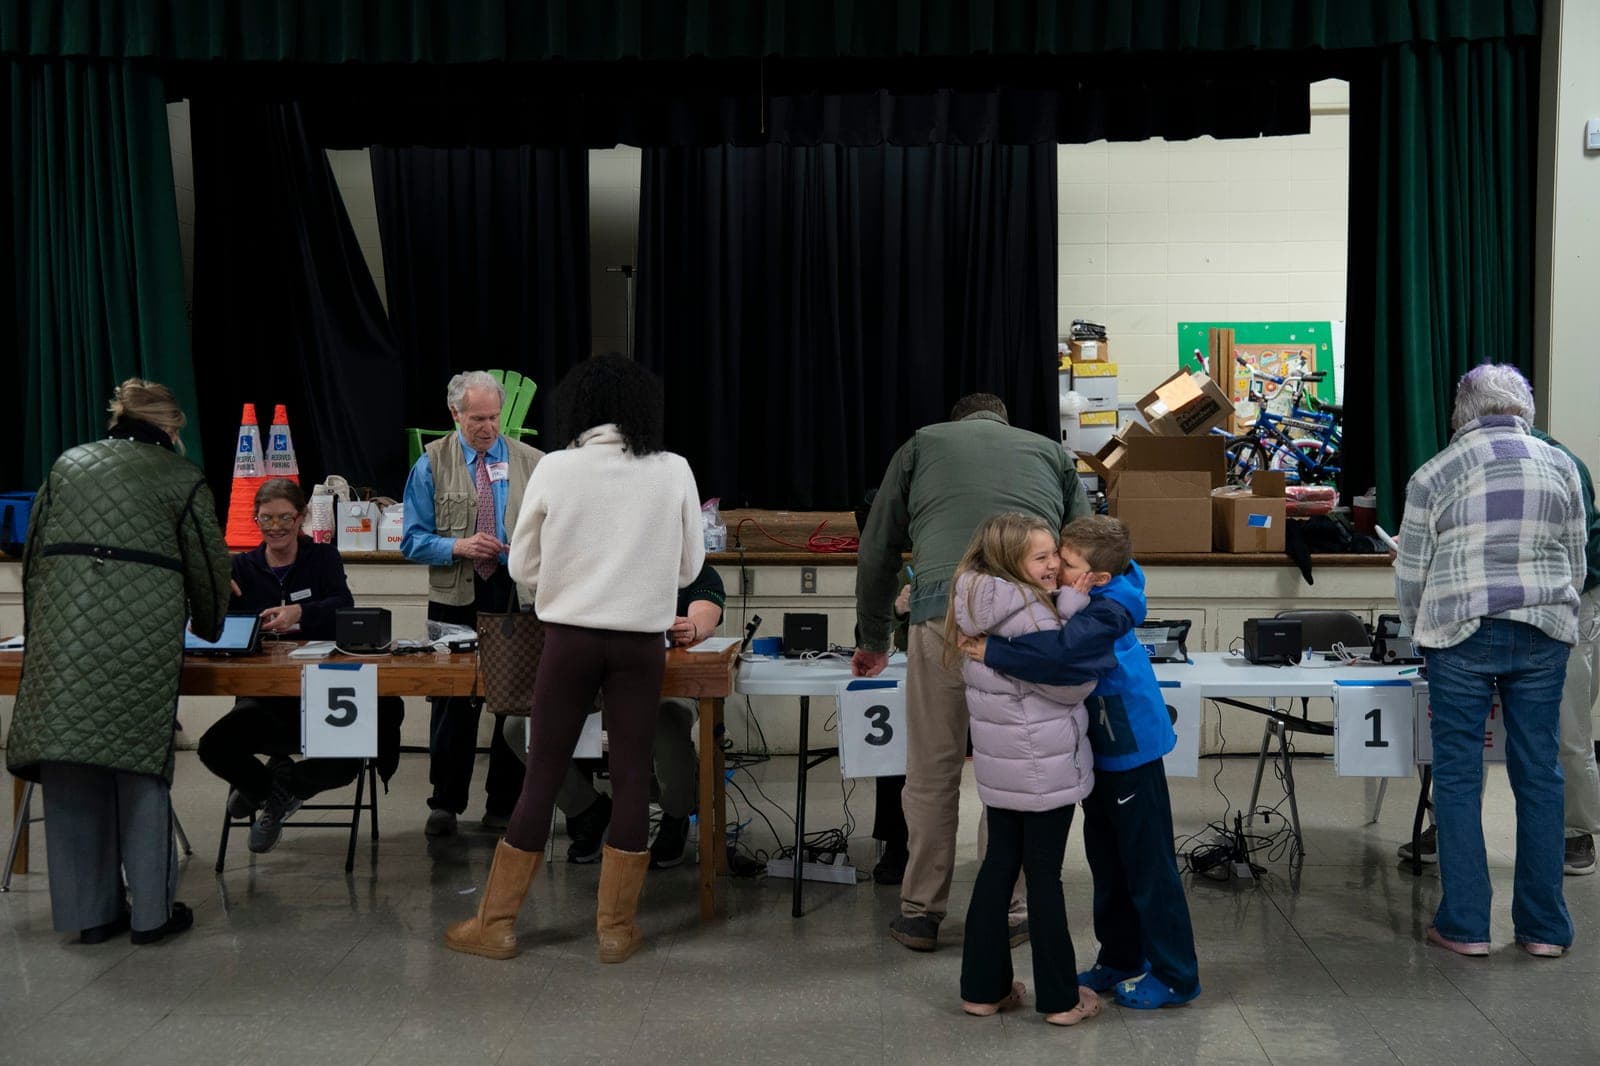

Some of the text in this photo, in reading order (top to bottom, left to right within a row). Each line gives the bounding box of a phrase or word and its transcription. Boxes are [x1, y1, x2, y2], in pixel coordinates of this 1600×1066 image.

[324, 687, 358, 728] 5
[864, 705, 894, 746] 3
[1364, 708, 1389, 748] 1
